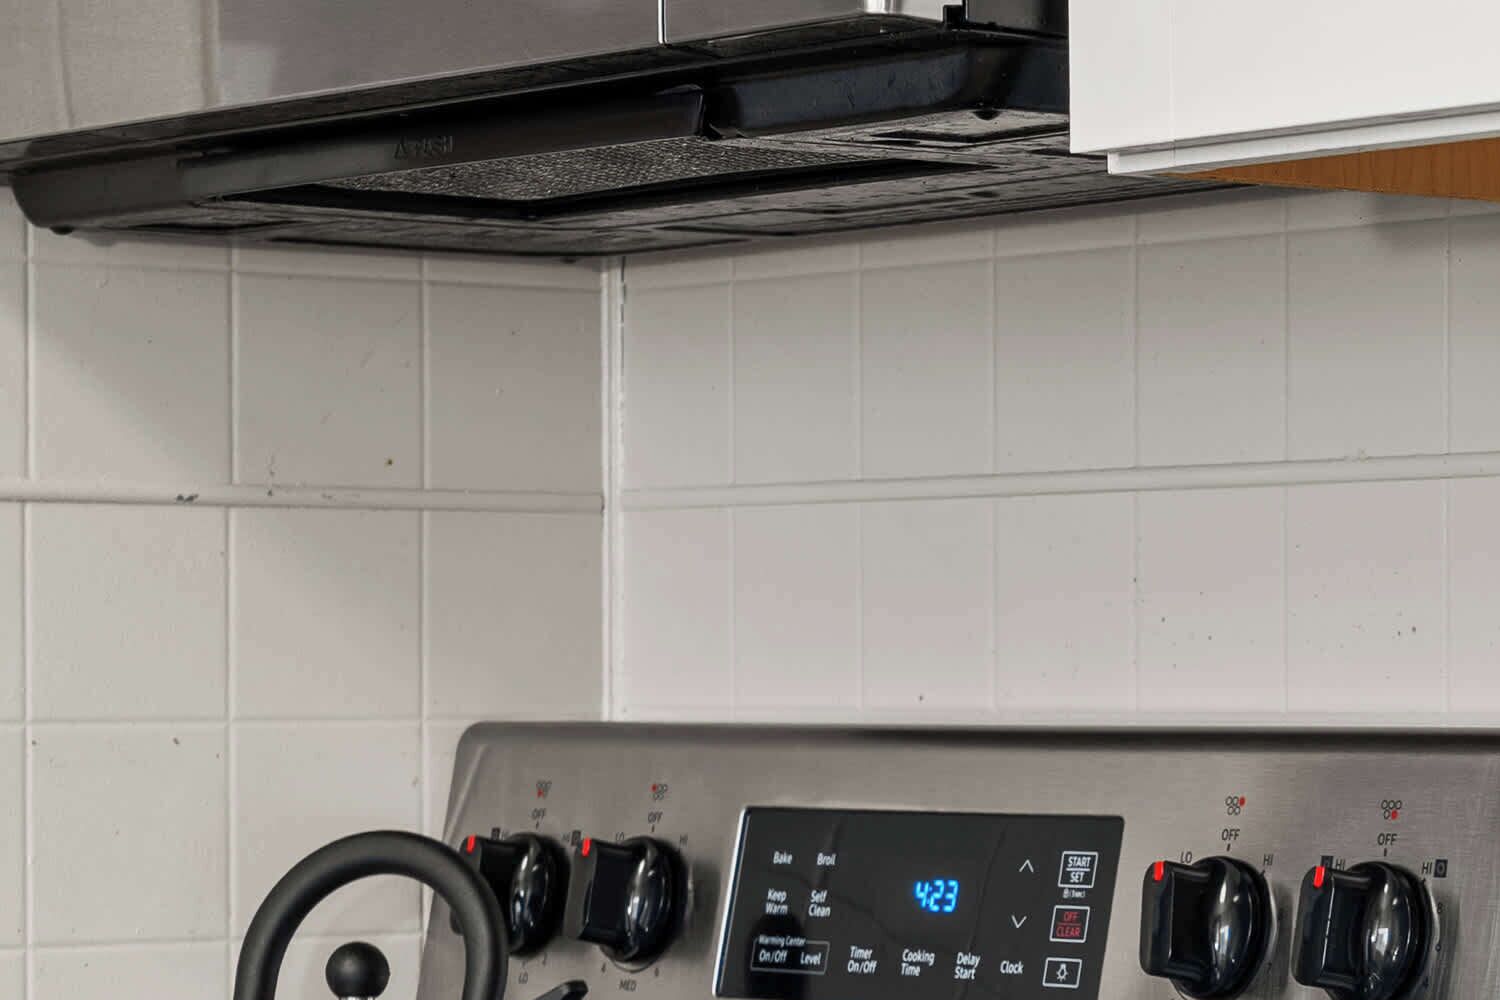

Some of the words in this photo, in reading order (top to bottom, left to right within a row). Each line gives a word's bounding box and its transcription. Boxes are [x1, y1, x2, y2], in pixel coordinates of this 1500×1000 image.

[647, 812, 663, 823] OFF
[1221, 828, 1241, 841] OFF
[1377, 833, 1397, 845] OFF
[773, 851, 793, 864] Bake
[817, 853, 837, 866] Broil
[1068, 856, 1091, 867] START
[1180, 851, 1193, 864] LO
[1263, 854, 1274, 866] HI
[1421, 862, 1433, 874] HI
[1070, 872, 1085, 882] SET
[767, 888, 787, 903] Keep
[810, 889, 828, 903] Self
[914, 879, 960, 912] 4:23
[765, 903, 788, 914] Warm
[808, 904, 831, 917] Clean
[1063, 911, 1079, 921] OFF
[1056, 927, 1081, 937] CLEAR
[759, 935, 785, 947] Warming
[786, 935, 807, 947] Center
[759, 950, 788, 963] On/Off
[800, 952, 821, 965] Level
[850, 946, 873, 959] Timer
[902, 949, 936, 965] Cooking
[956, 952, 981, 967] Delay
[847, 960, 877, 974] On/Off
[900, 964, 921, 977] Time
[954, 966, 976, 980] Start
[1000, 961, 1024, 974] Clock
[518, 972, 529, 984] LO
[619, 979, 637, 991] MED
